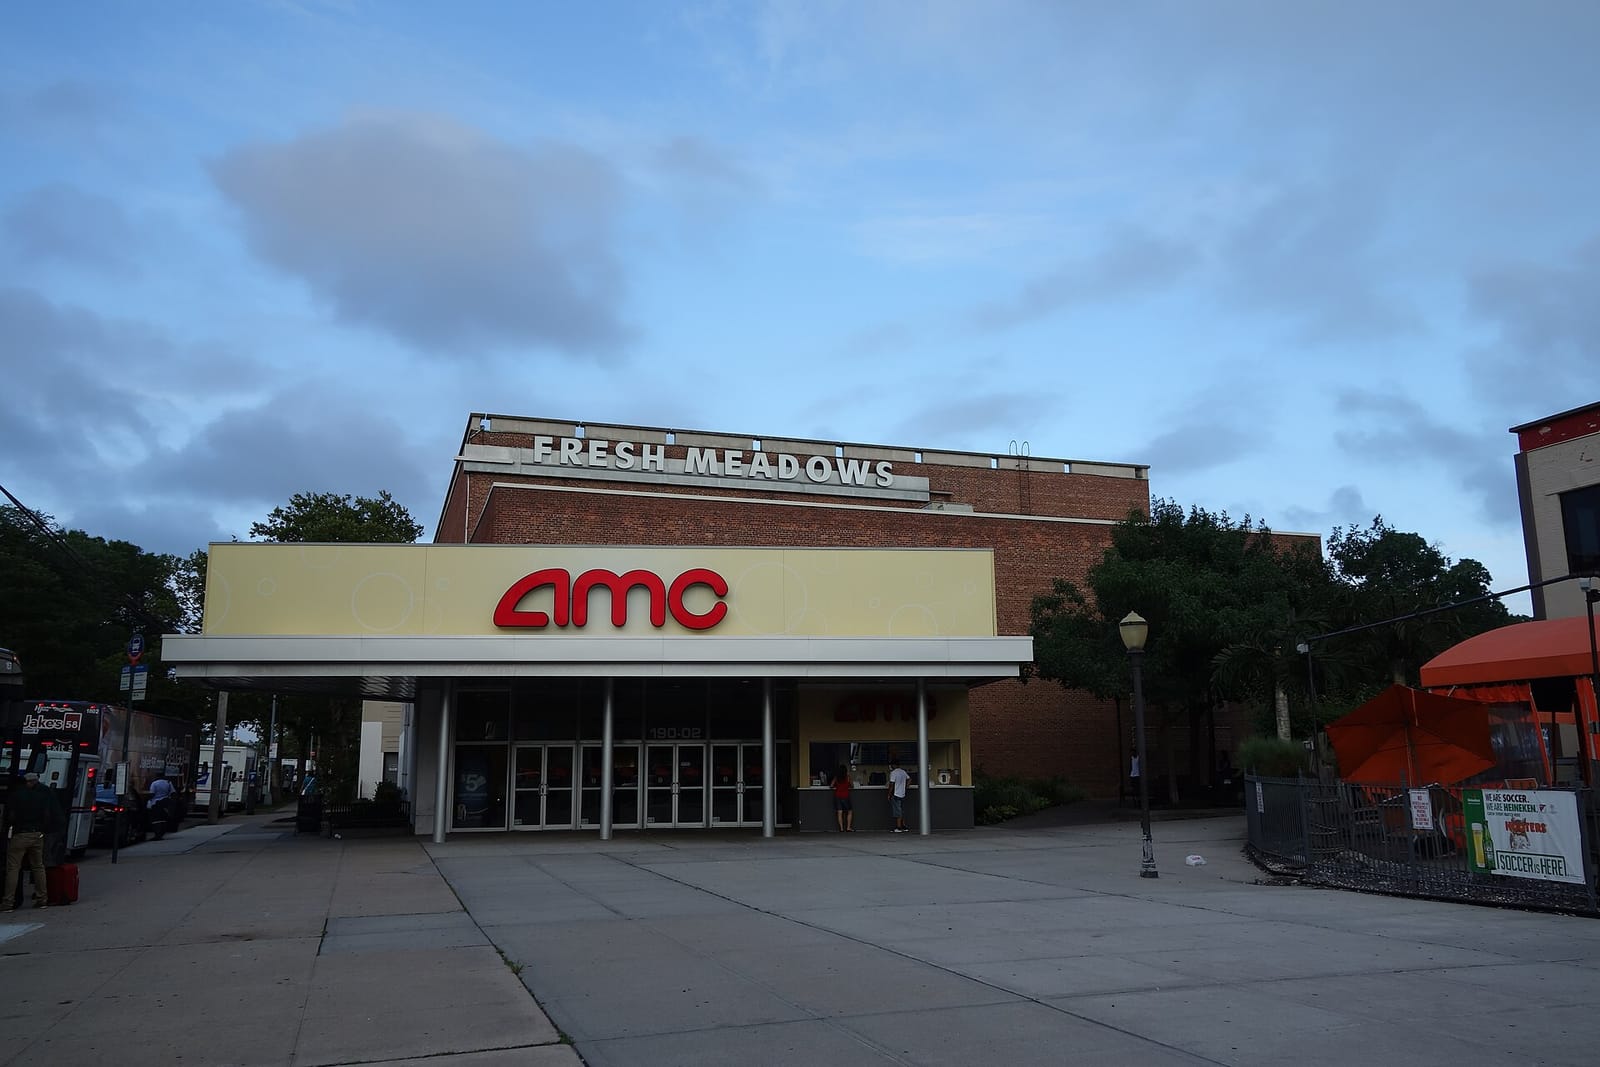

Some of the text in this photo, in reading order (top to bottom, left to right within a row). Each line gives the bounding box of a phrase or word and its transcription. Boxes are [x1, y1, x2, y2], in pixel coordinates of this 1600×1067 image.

[533, 436, 895, 487] FRESH MEADOWS
[23, 714, 79, 730] Jake's 58
[1485, 793, 1492, 802] WE
[1493, 794, 1502, 802] ARE
[1486, 803, 1493, 811] WE
[1505, 820, 1547, 833] HOOTERS
[1500, 855, 1533, 873] SOCCER
[1540, 858, 1564, 876] HERE
